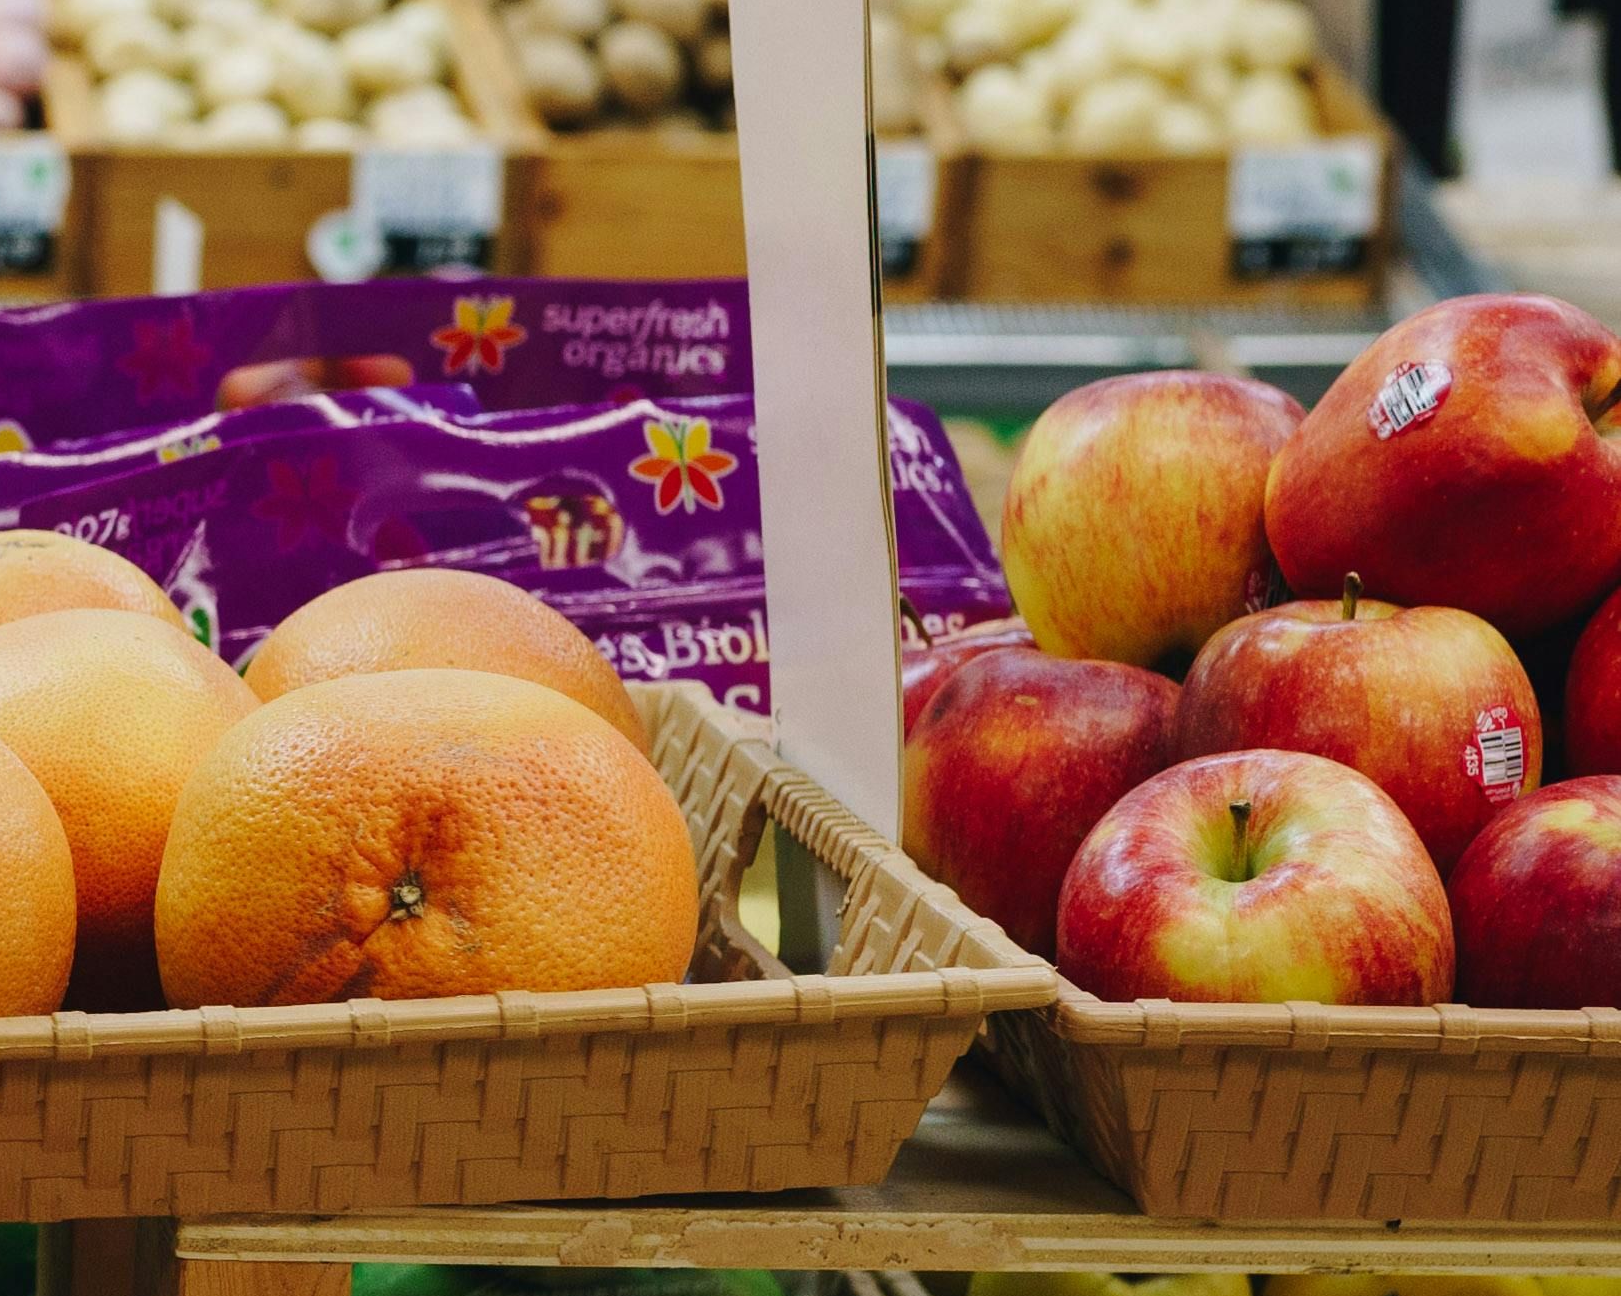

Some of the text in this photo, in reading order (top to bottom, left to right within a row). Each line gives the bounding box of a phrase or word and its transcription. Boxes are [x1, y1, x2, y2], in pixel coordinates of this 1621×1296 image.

[542, 298, 730, 347] superfresh
[563, 341, 726, 379] organics
[1464, 745, 1479, 776] 4135
